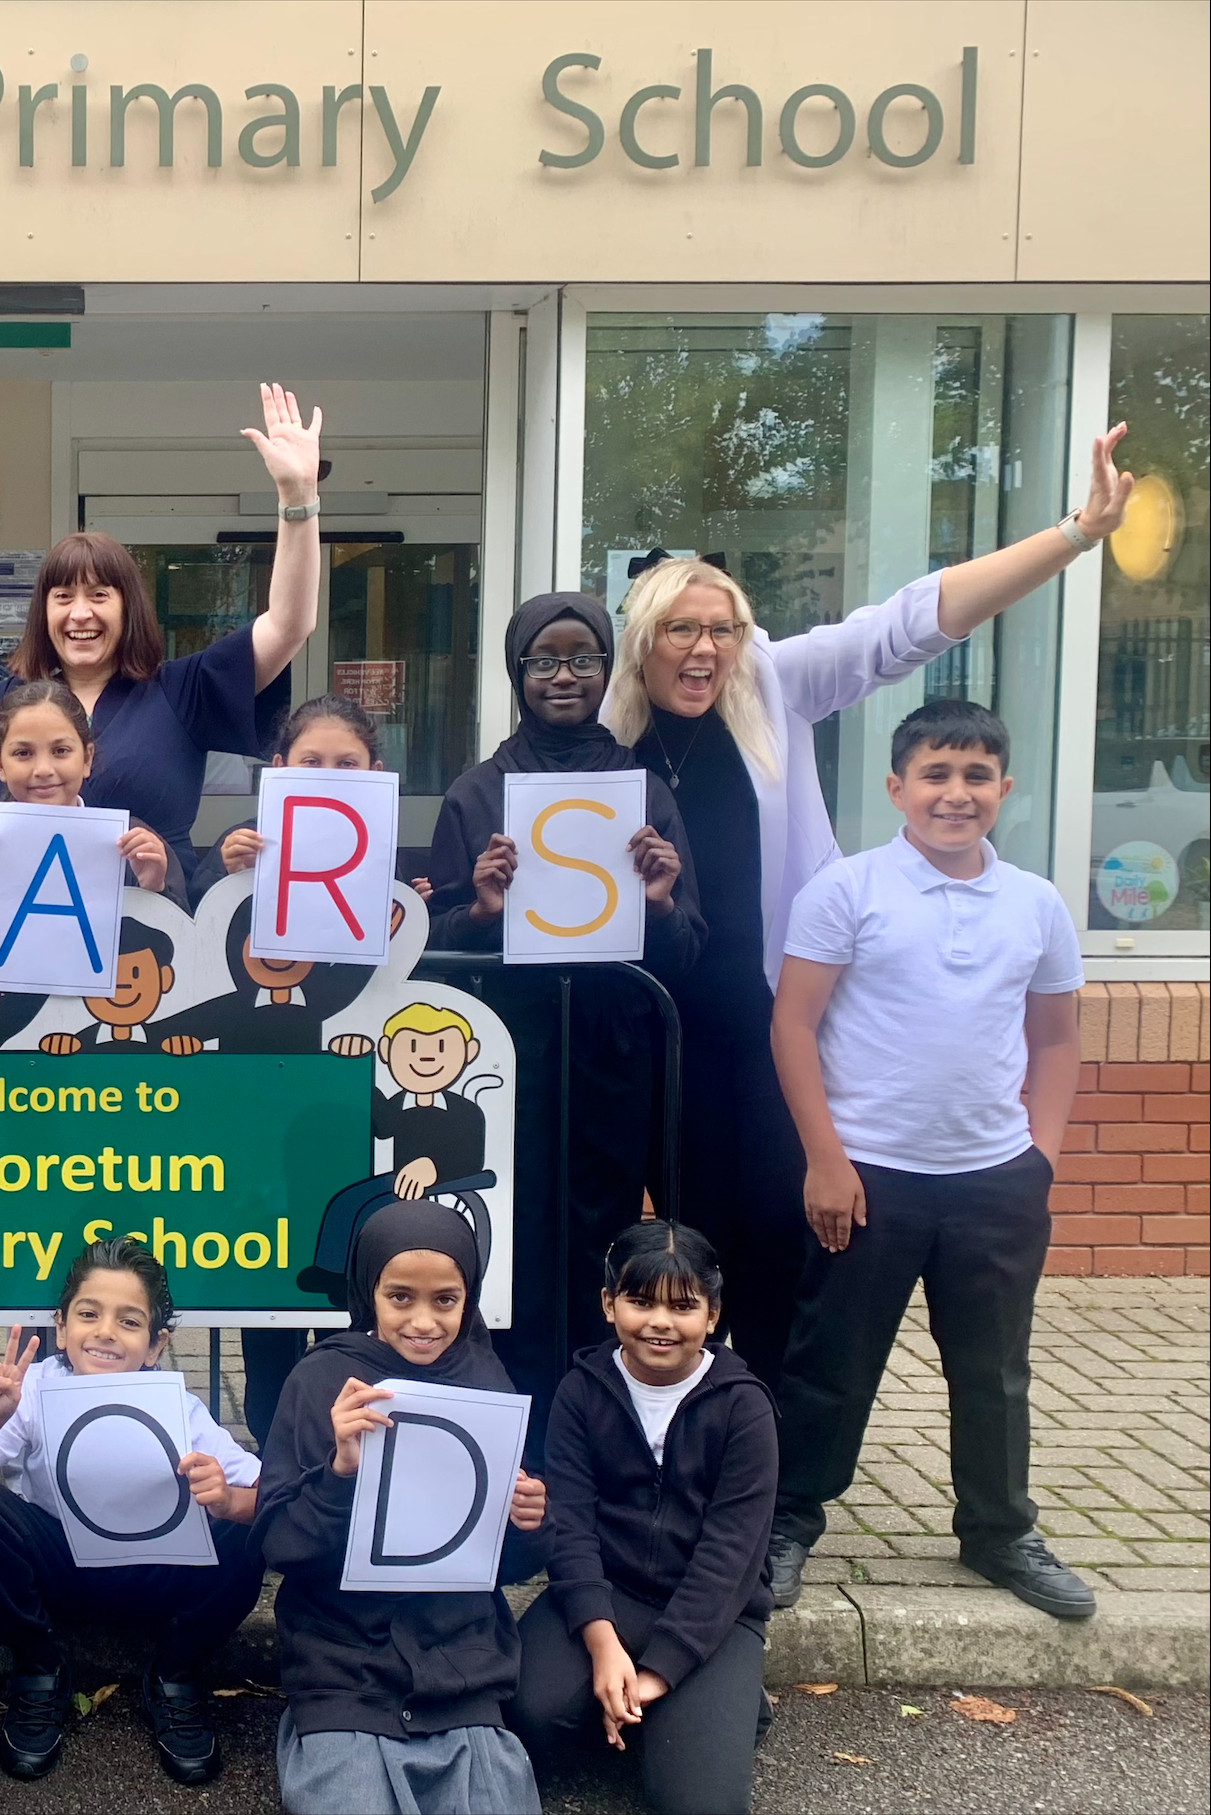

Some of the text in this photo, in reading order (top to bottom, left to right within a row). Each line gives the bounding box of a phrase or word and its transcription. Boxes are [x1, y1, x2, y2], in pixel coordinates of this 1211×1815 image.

[540, 47, 977, 168] School
[276, 795, 369, 941] R
[525, 799, 619, 937] S
[1111, 887, 1149, 906] Mile
[136, 1082, 180, 1112] to
[56, 1403, 190, 1542] O
[371, 1411, 488, 1566] D
